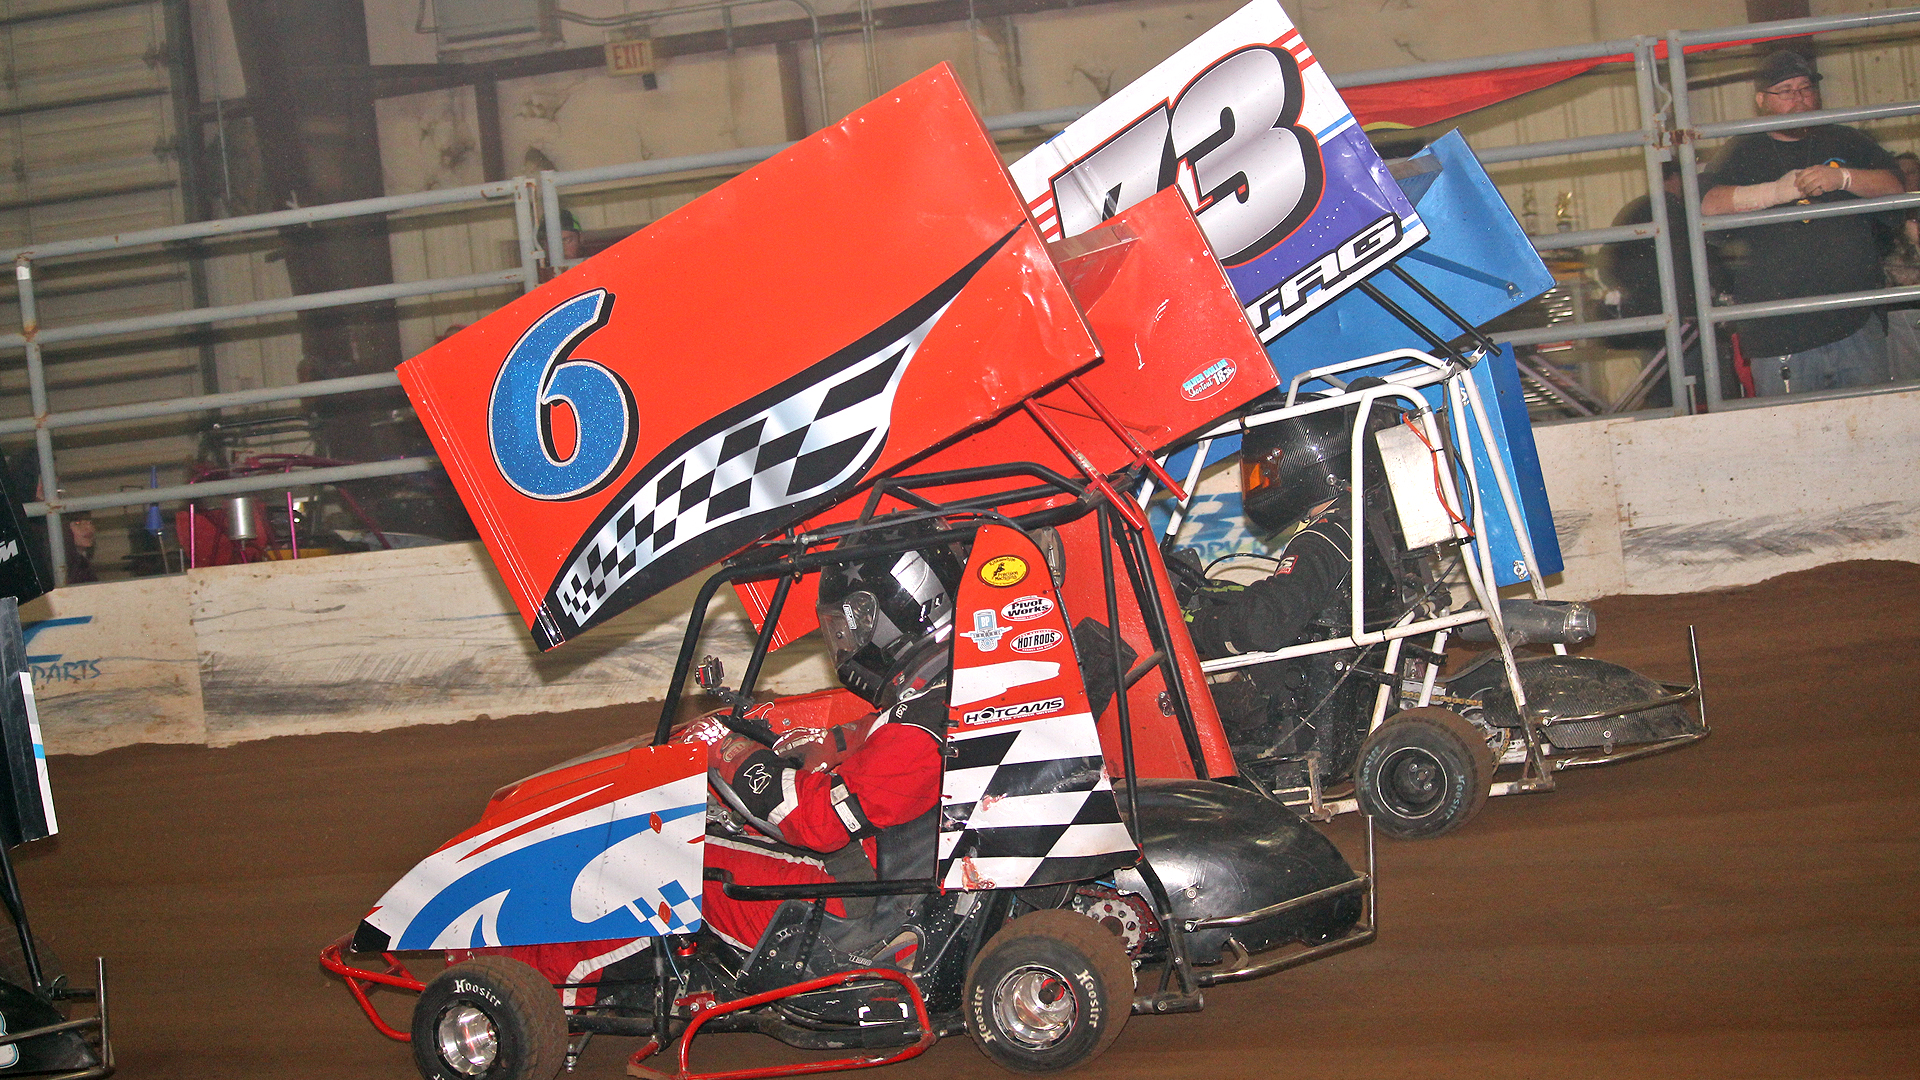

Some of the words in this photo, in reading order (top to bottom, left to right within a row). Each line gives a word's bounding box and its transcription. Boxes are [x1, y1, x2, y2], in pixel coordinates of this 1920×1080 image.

[612, 42, 645, 70] EXIT
[1049, 43, 1326, 268] 73
[1182, 373, 1206, 391] SILVER
[1202, 359, 1229, 379] DOLLAR
[487, 287, 640, 502] 6
[1007, 604, 1049, 617] Works
[1011, 599, 1043, 610] Pivot
[980, 616, 990, 628] BP
[1017, 635, 1033, 649] HOT
[1033, 632, 1055, 646] RODS
[32, 657, 102, 686] PARTS
[1445, 774, 1466, 820] Hoosier
[453, 979, 501, 1007] Hoosier
[1073, 969, 1103, 1029] Hoosier
[971, 985, 997, 1044] Hoosier
